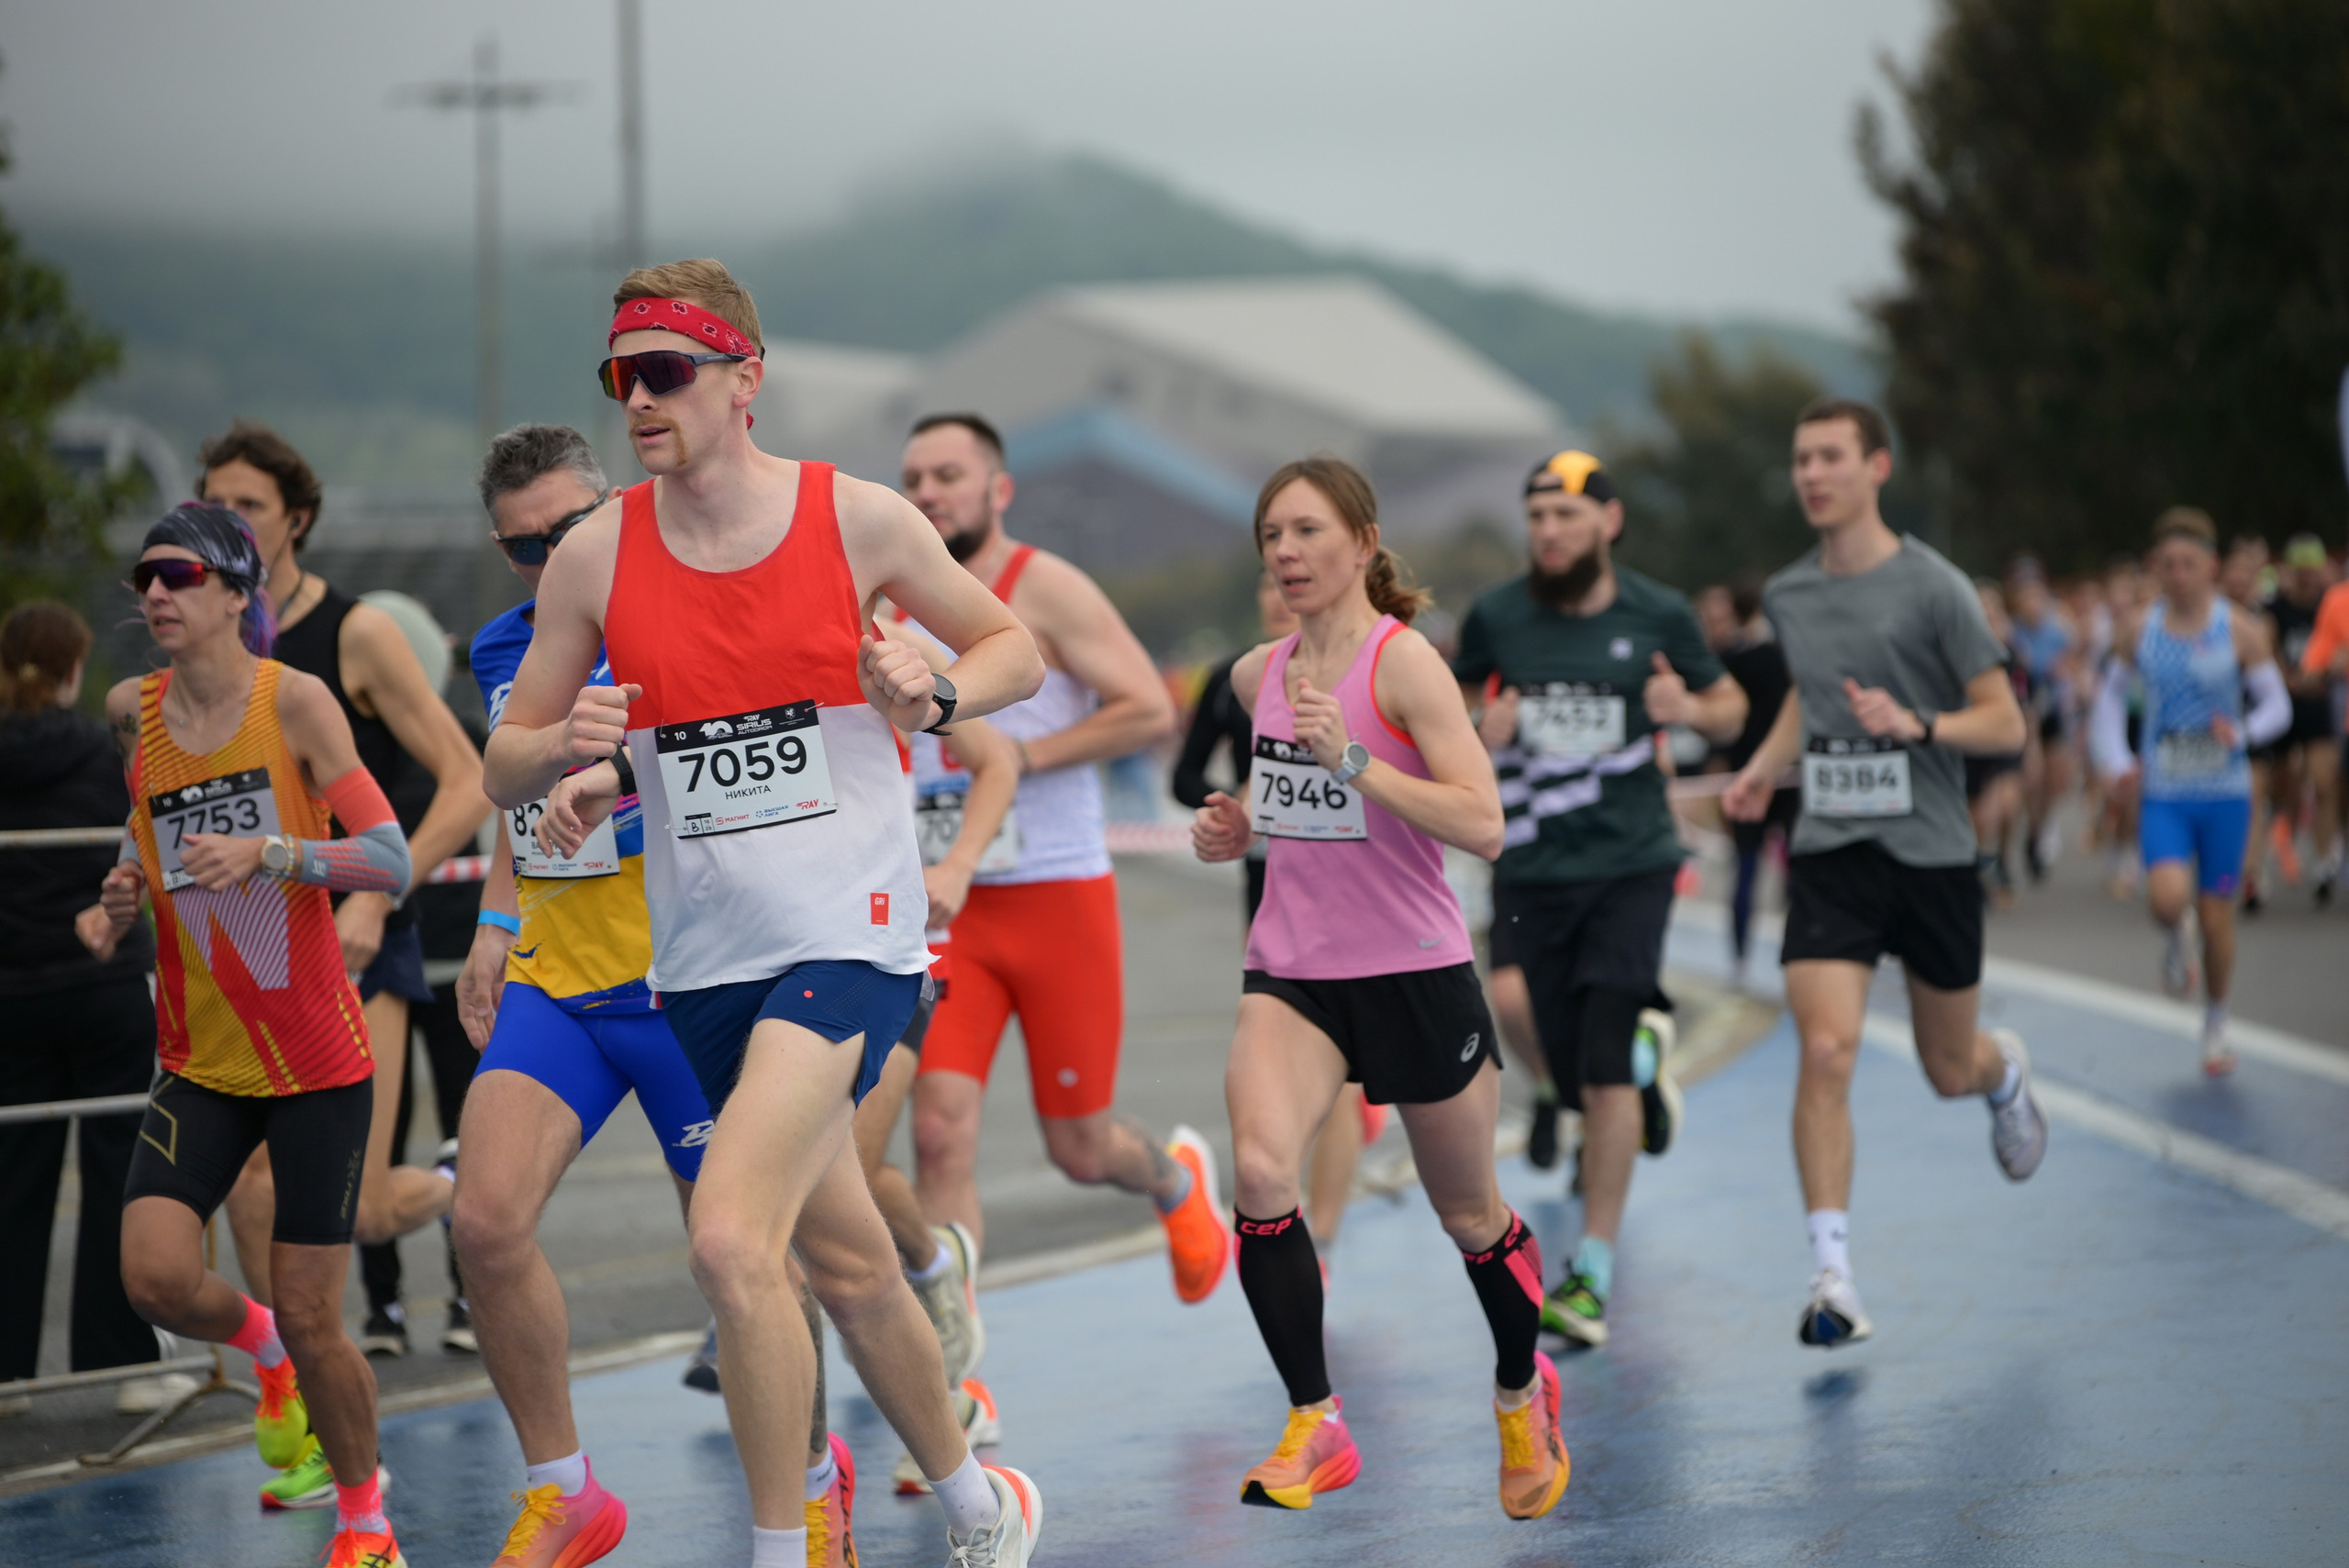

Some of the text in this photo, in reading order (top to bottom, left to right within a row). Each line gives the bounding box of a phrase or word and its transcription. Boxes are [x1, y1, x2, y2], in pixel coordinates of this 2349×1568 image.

[736, 718, 772, 731] SIRIUS
[737, 725, 773, 735] AUTODROM
[674, 731, 686, 740] 10
[678, 736, 807, 793] 7059
[725, 784, 772, 800] НИКИТА
[1261, 772, 1347, 809] 7946
[796, 799, 819, 810] RAY
[167, 798, 261, 850] 7753
[513, 802, 544, 837] 82
[725, 814, 751, 823] МАГНИТ
